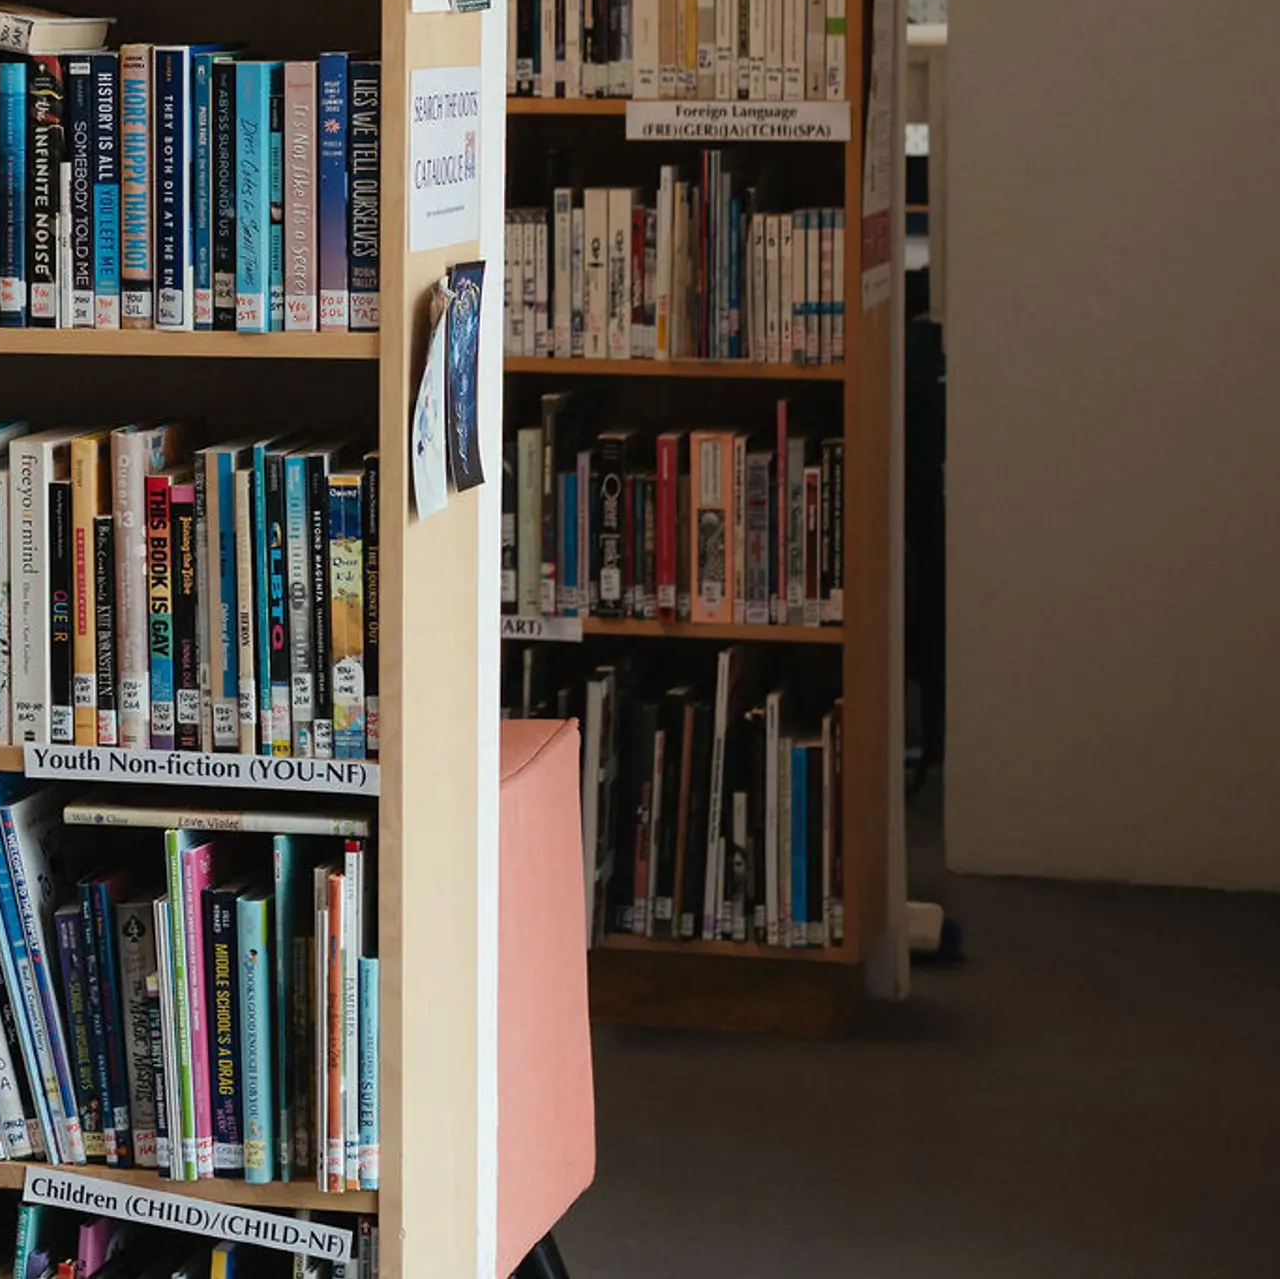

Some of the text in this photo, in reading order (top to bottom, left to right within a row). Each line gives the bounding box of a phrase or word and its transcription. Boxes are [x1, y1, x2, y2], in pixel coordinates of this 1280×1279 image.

[98, 72, 116, 276] HISTORY IS ALL YOU LEFT ME
[123, 78, 147, 272] MORE HAPPY THAN NOT
[352, 78, 378, 258] LIES WE TELL OURSELVES
[675, 105, 798, 122] Foreign Language
[74, 120, 90, 286] SOMEBODY TOLD ME
[150, 488, 170, 658] THIS BOOK IS GAY
[313, 510, 323, 604] BEYOND MAGENTA
[34, 748, 367, 787] Youth Non-fiction (YOU-NF)
[216, 942, 234, 1096] MIDDLE SCHOOL'S A DRAG
[360, 1080, 374, 1128] SUPER
[30, 1177, 345, 1255] Children (CHILD)/(CHILD-NF)
